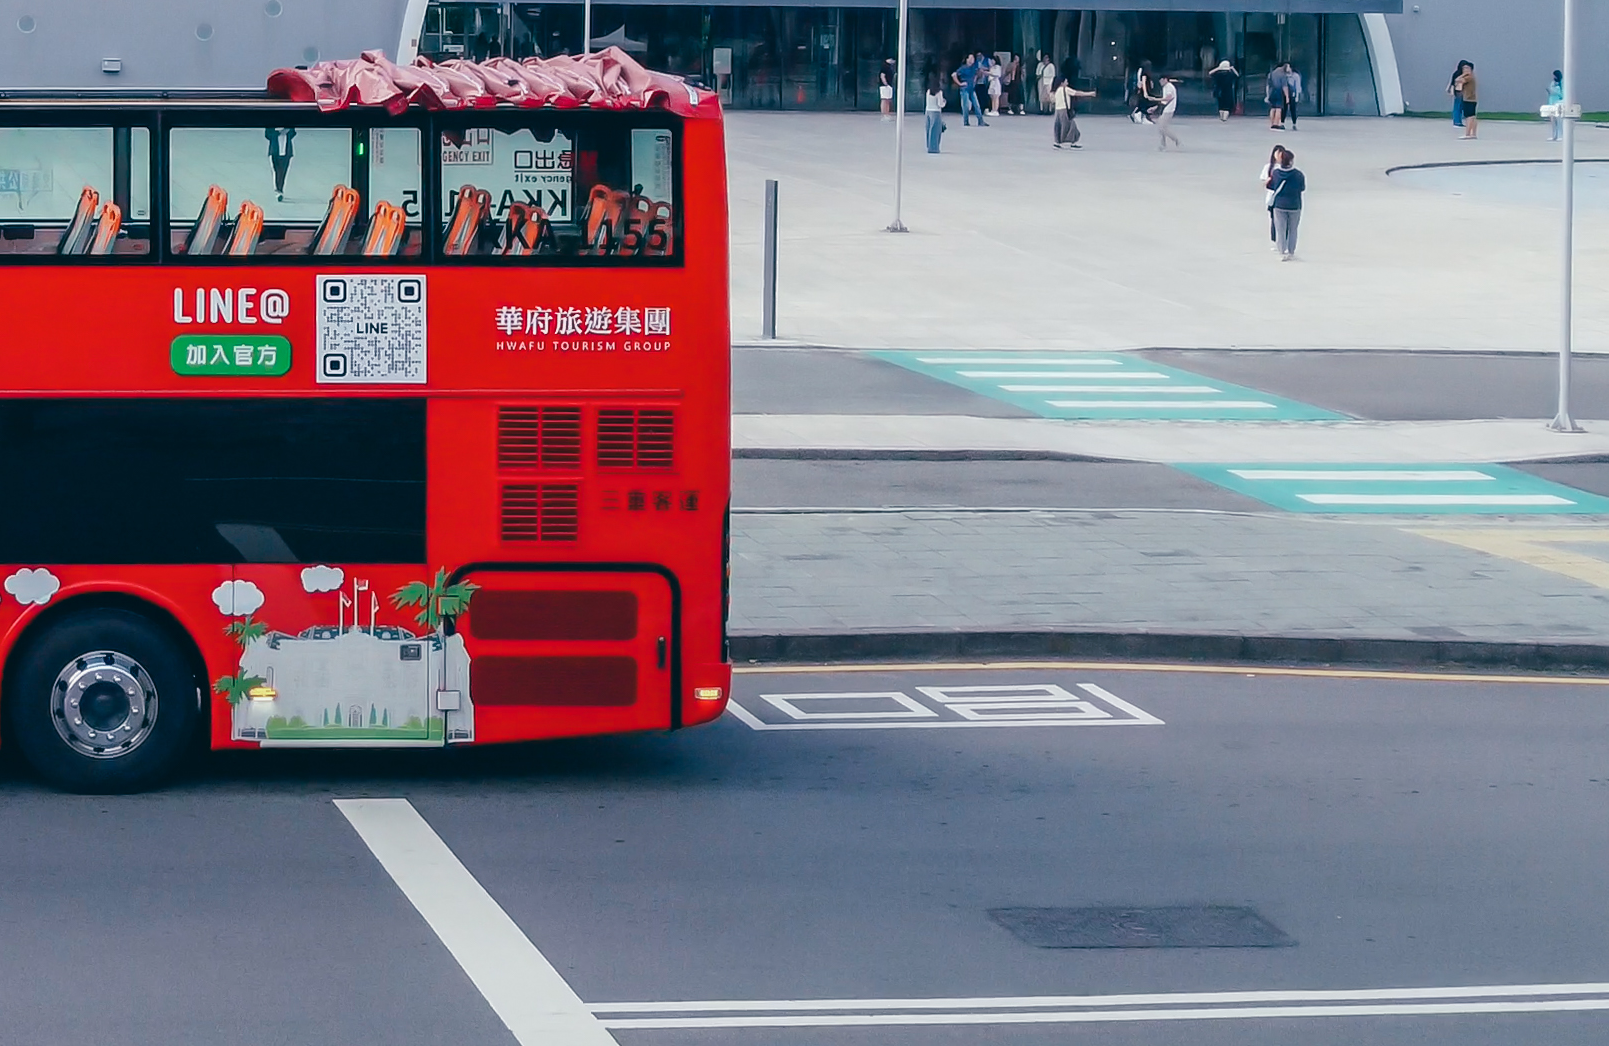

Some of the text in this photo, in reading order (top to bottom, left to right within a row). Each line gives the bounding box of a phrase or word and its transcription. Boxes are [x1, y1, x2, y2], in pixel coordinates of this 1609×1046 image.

[173, 288, 290, 325] LINE@
[356, 323, 388, 335] LINE
[495, 307, 671, 336] 華府旅遊集團
[186, 344, 277, 366] 加入官方
[496, 341, 671, 352] HWAFU TOURISM GROUP
